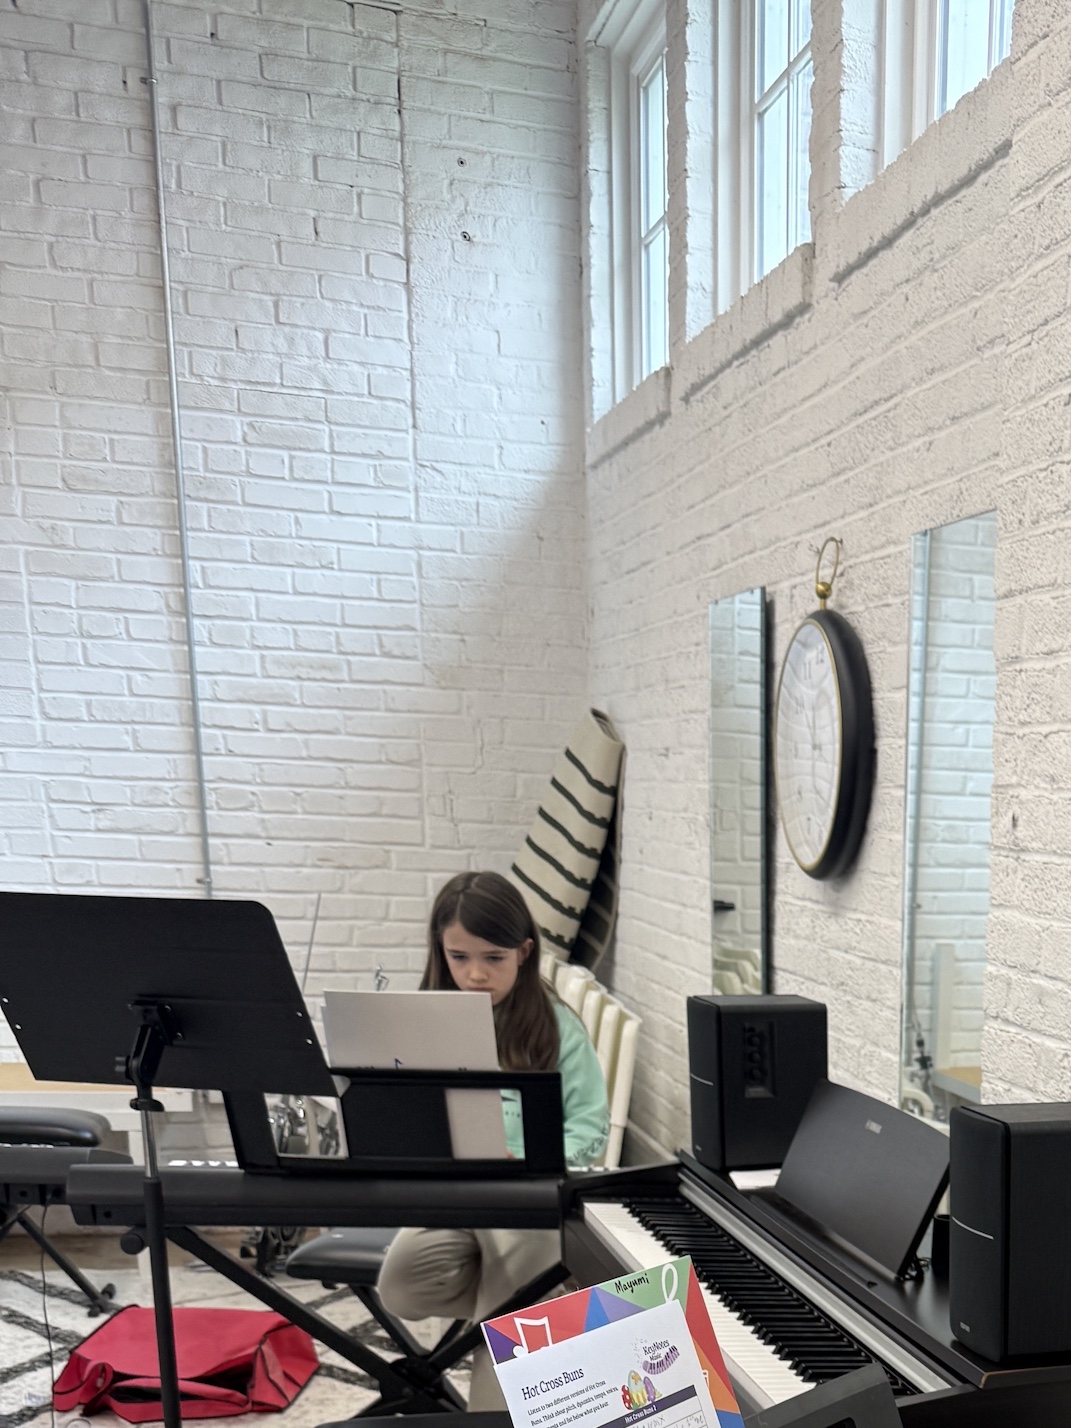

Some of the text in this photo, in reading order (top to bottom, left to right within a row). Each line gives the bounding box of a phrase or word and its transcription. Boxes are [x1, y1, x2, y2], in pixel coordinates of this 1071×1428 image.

[614, 1273, 649, 1293] Mayumi
[643, 1340, 670, 1355] KeyNotes
[522, 1368, 584, 1400] Hot Cross Buns
[624, 1414, 634, 1424] Hot
[633, 1410, 643, 1420] Cross
[643, 1407, 654, 1416] Buns
